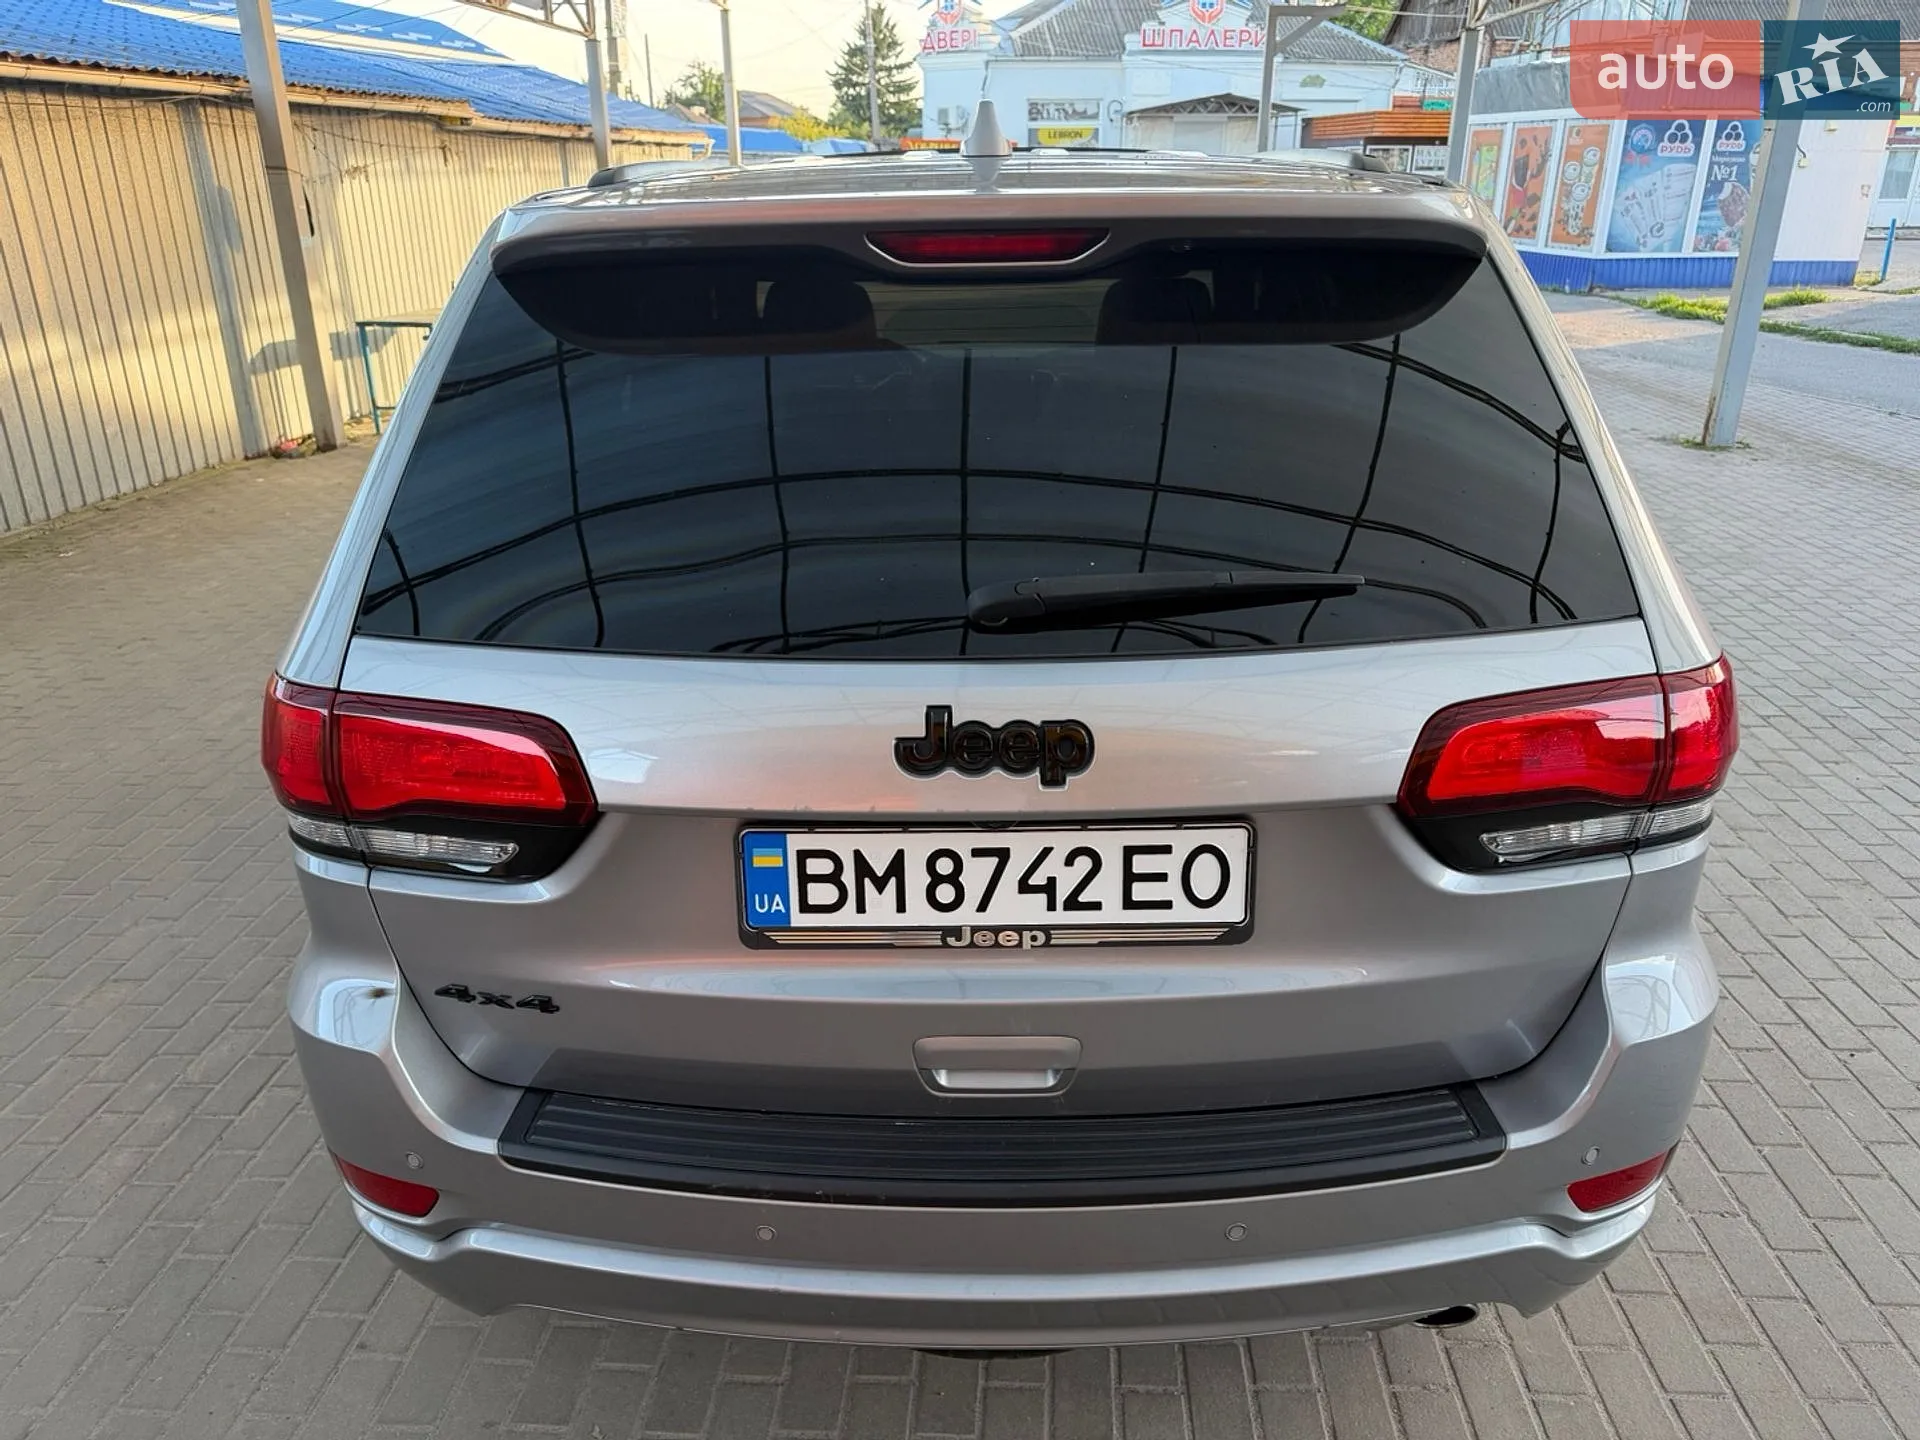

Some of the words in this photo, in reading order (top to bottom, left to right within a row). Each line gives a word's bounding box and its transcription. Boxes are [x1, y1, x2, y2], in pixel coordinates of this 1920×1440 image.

[922, 29, 977, 51] ДВЕРІ
[894, 704, 1095, 788] Jeep
[796, 847, 906, 914] BM
[925, 845, 1103, 913] 8742
[1122, 844, 1231, 910] EO
[754, 893, 786, 914] UA
[945, 926, 1049, 950] Jeep
[435, 983, 560, 1014] 4x4
